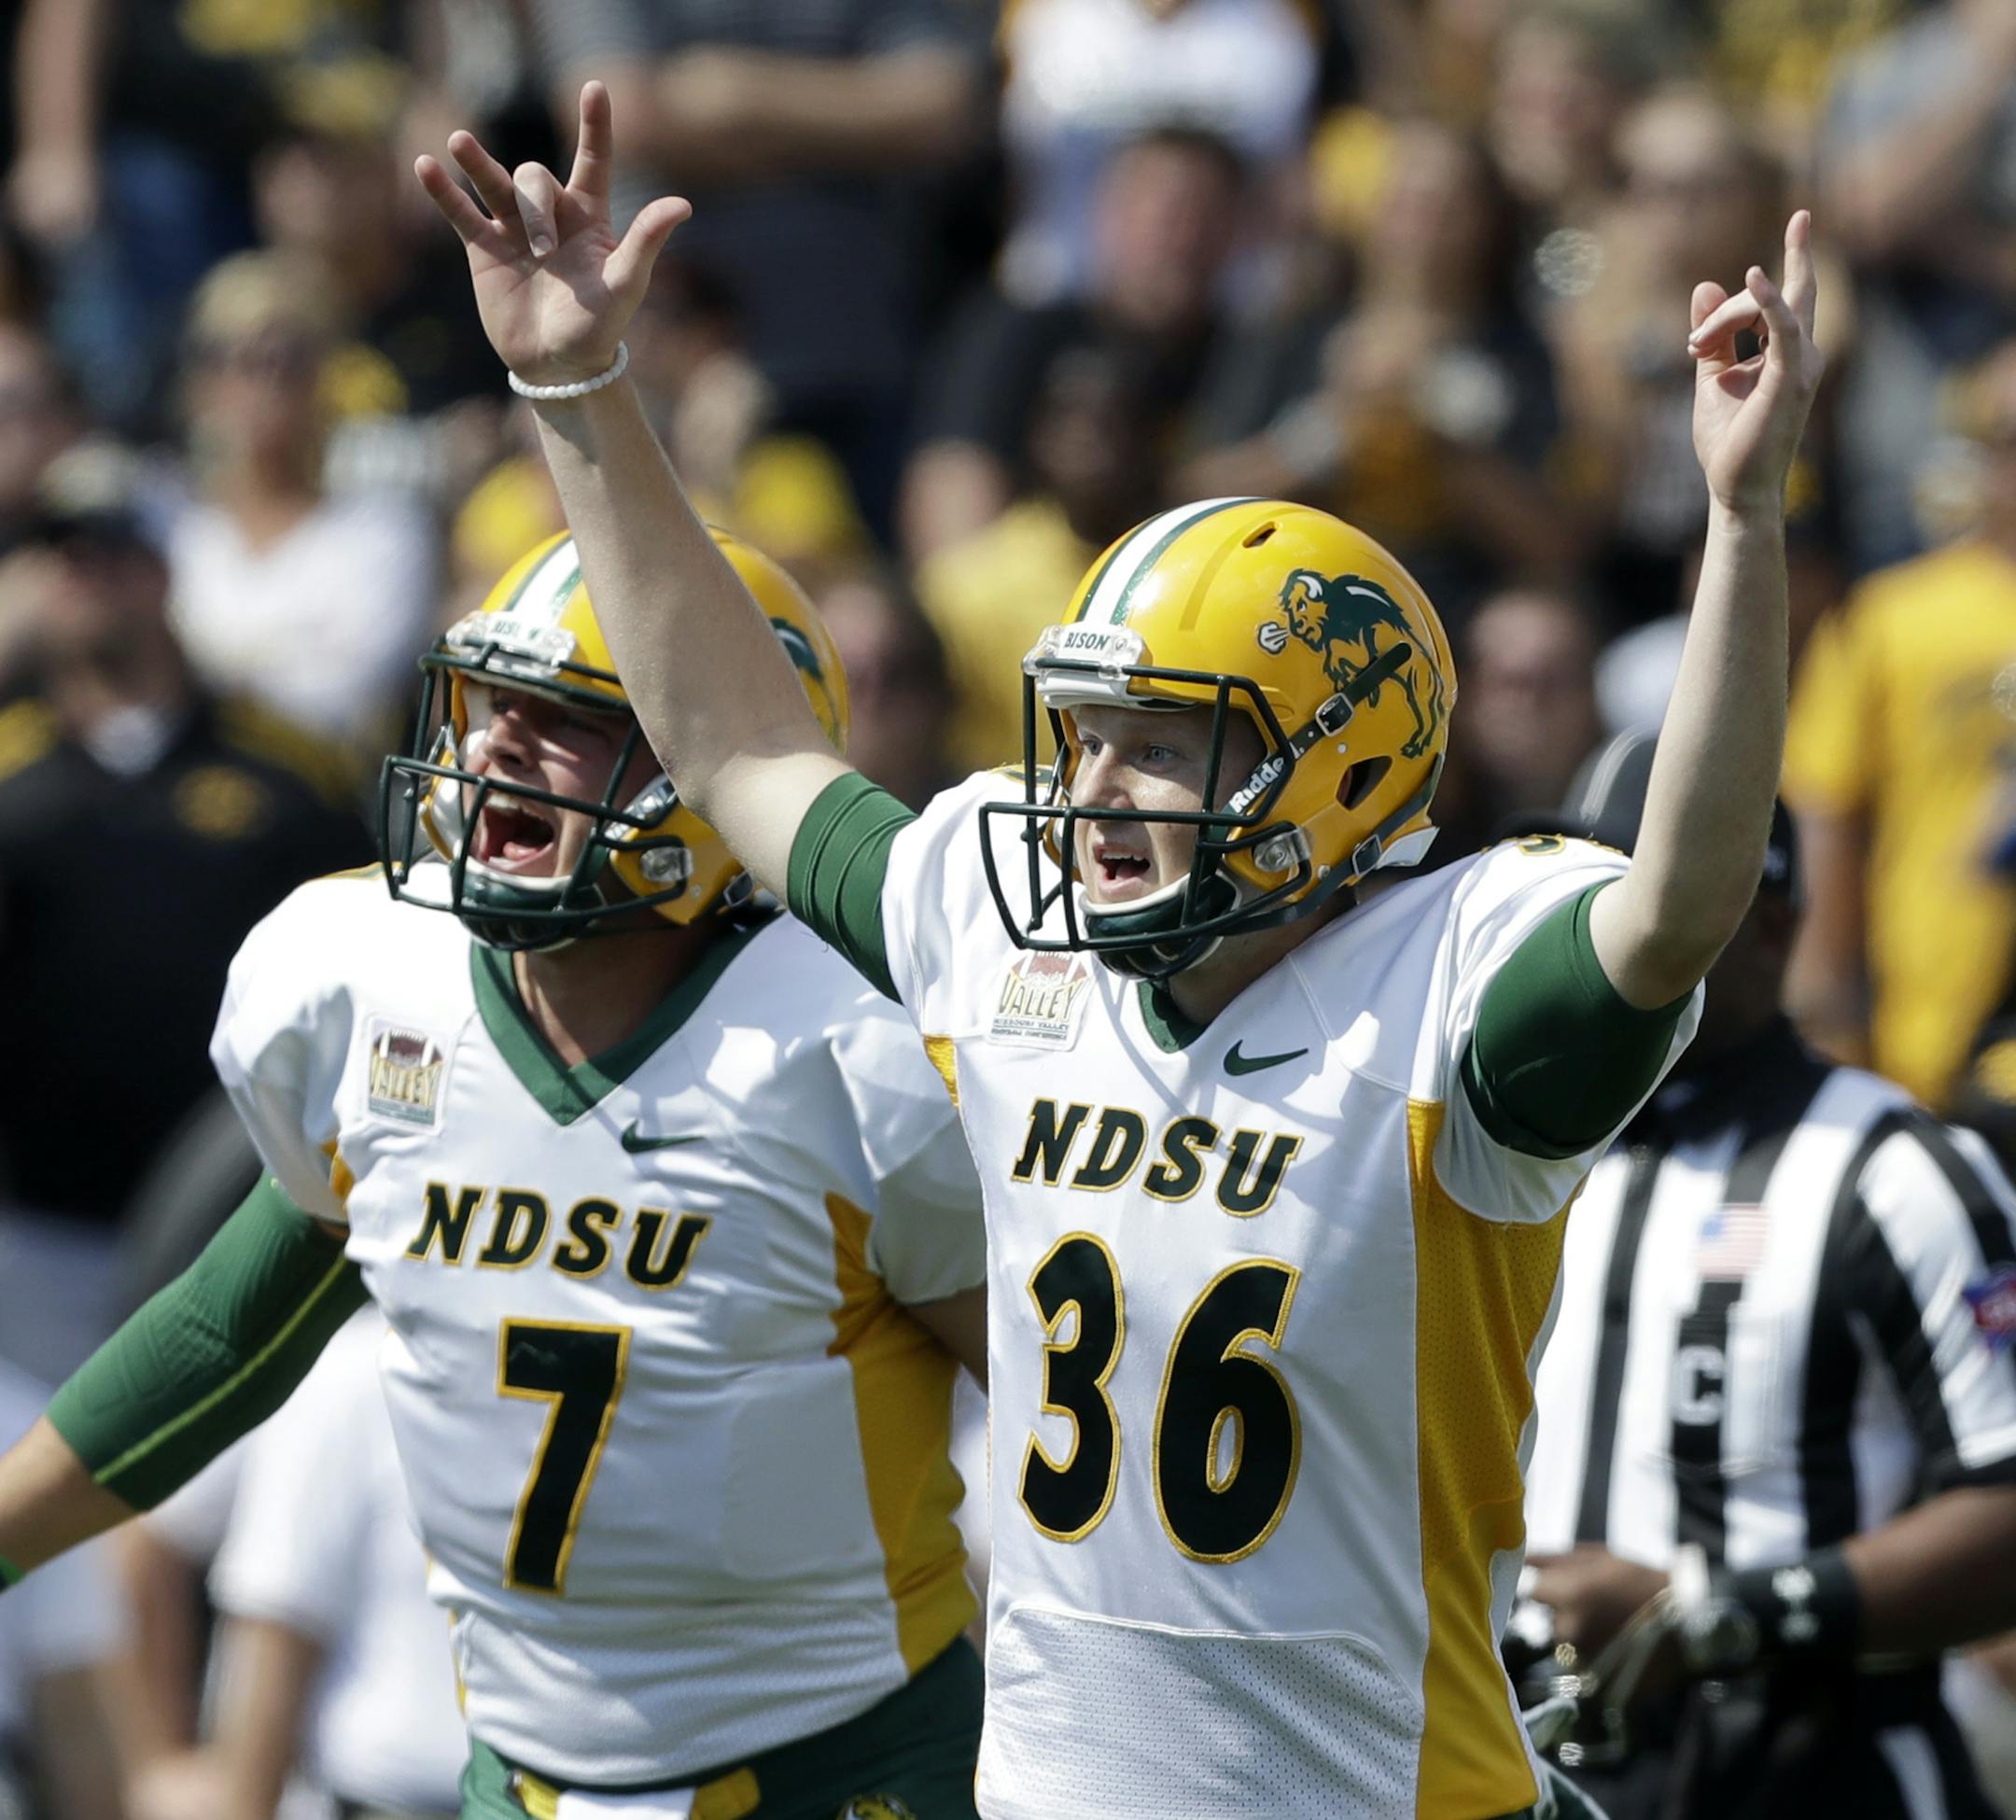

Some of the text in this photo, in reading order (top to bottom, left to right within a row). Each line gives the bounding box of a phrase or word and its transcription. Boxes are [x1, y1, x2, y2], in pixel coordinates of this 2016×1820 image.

[1064, 632, 1111, 651] BISON
[1228, 757, 1284, 814] Ridde
[995, 971, 1085, 1022] VALLEY
[1010, 1097, 1304, 1217] NDSU
[402, 1180, 712, 1292] NDSU
[1017, 1231, 1303, 1564] 36
[1671, 1344, 1726, 1426] C
[496, 1317, 633, 1597] 7
